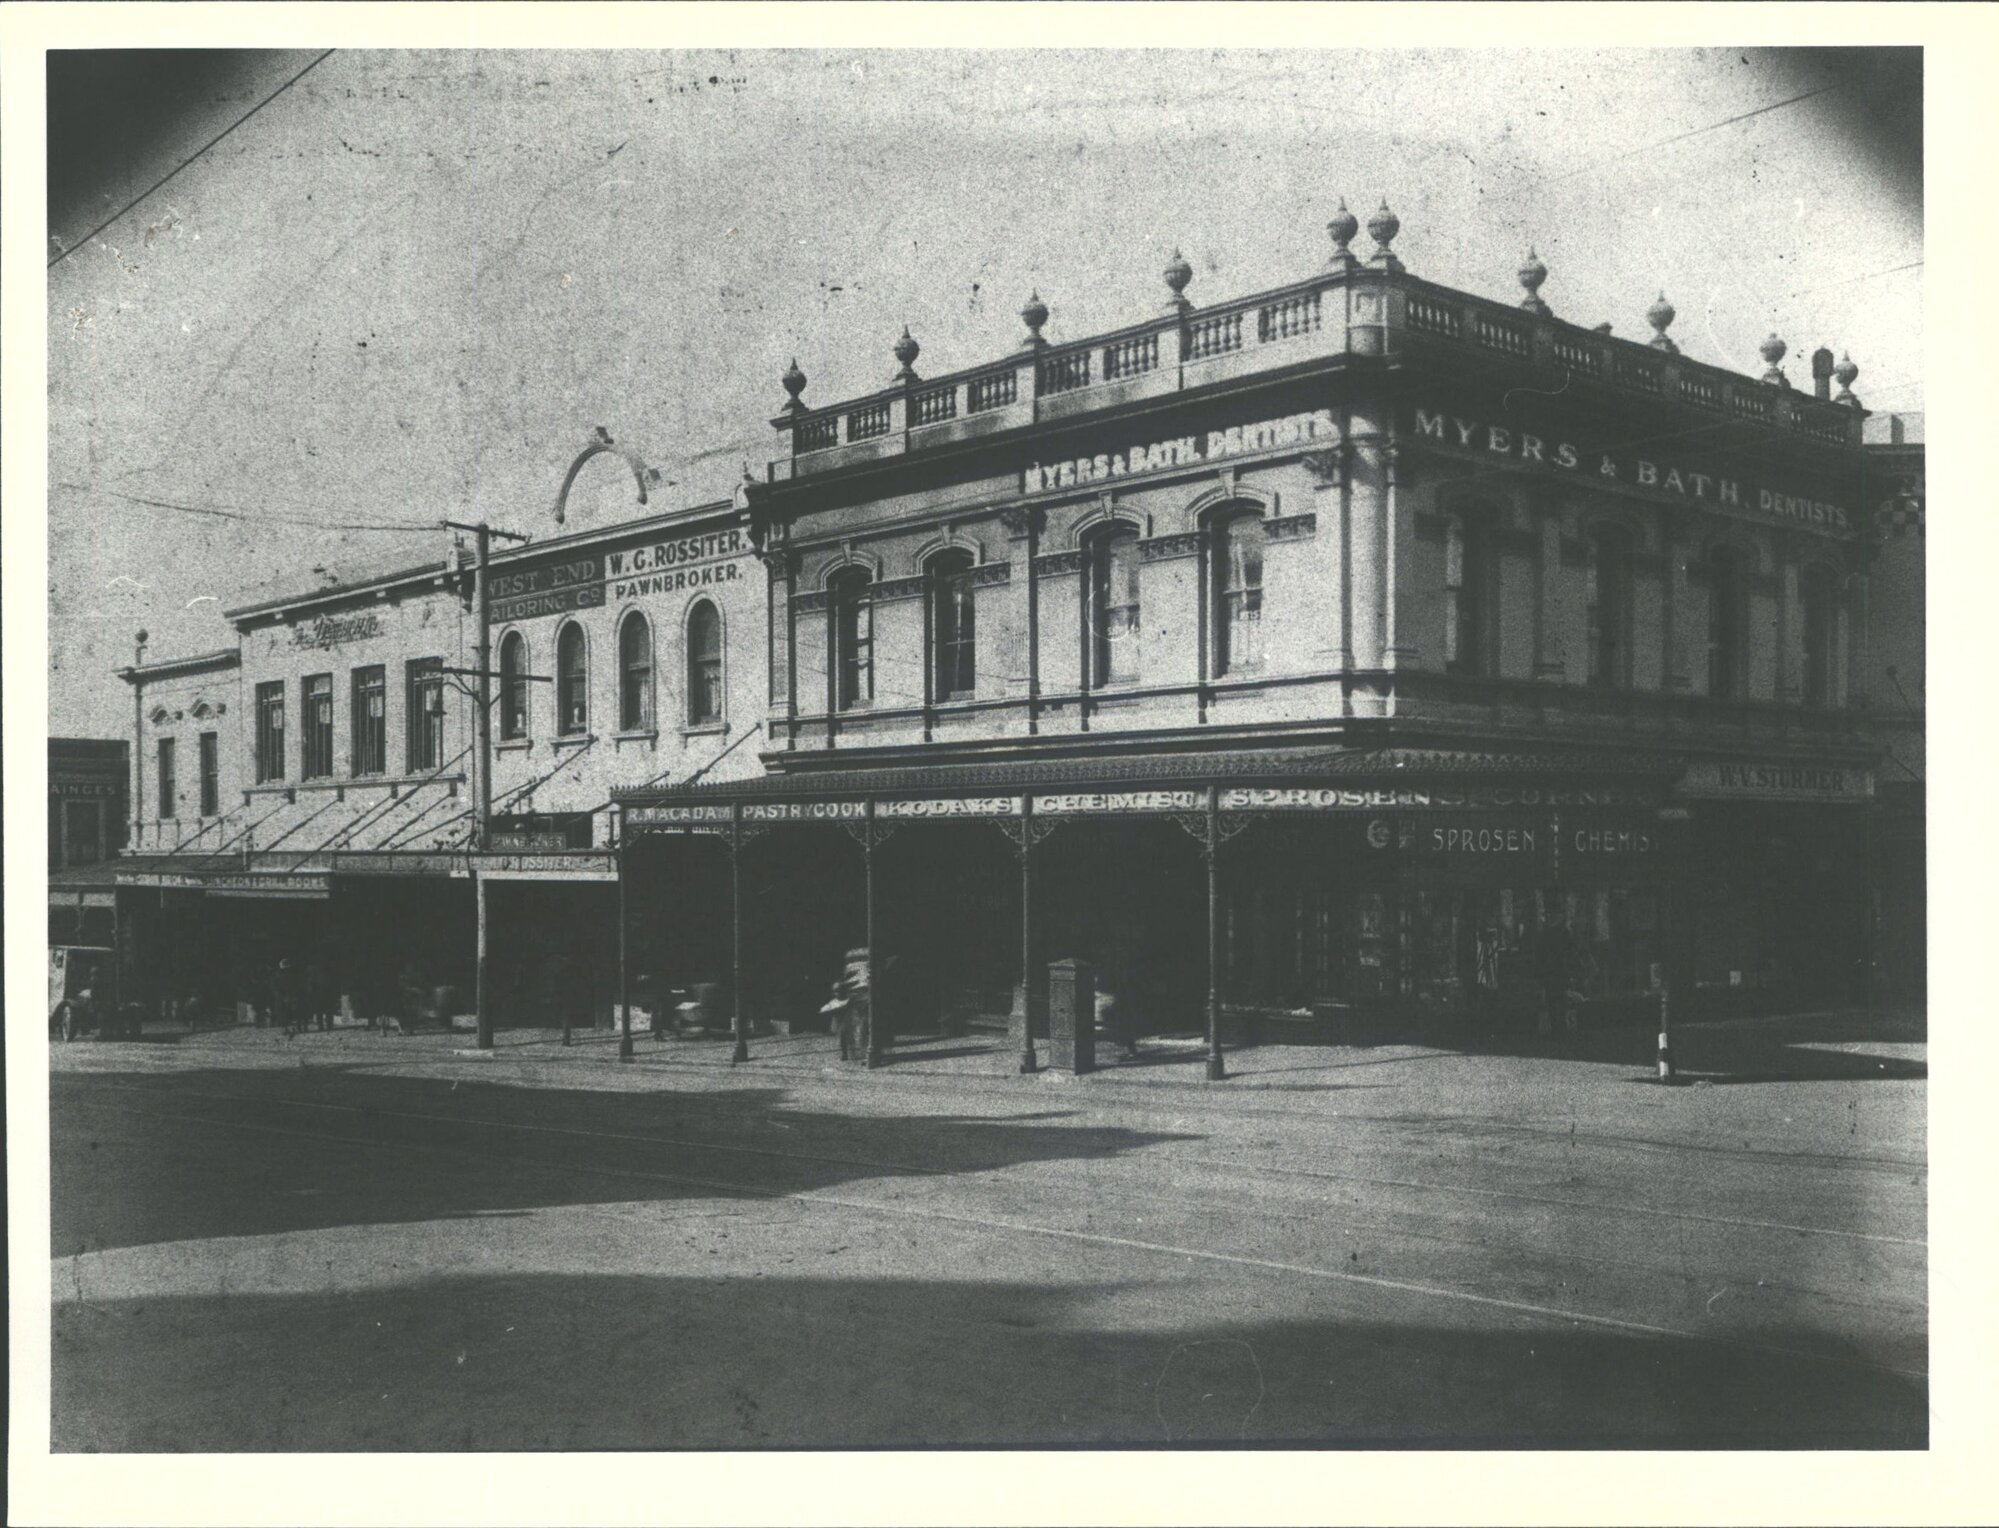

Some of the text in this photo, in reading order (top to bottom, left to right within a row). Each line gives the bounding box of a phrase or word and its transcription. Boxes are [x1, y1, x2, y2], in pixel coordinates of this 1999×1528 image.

[1024, 454, 1109, 493] MYERS
[1411, 408, 1578, 468] MYERS
[1600, 455, 1616, 477] &
[1759, 488, 1848, 527] DENTISTS
[551, 560, 595, 586] END
[616, 563, 743, 599] PAWNBROKER.
[489, 595, 565, 621] AILORING
[888, 796, 1013, 817] KODAKS
[1040, 788, 1195, 812] CHEMIST
[1432, 828, 1535, 852] SPROSEN
